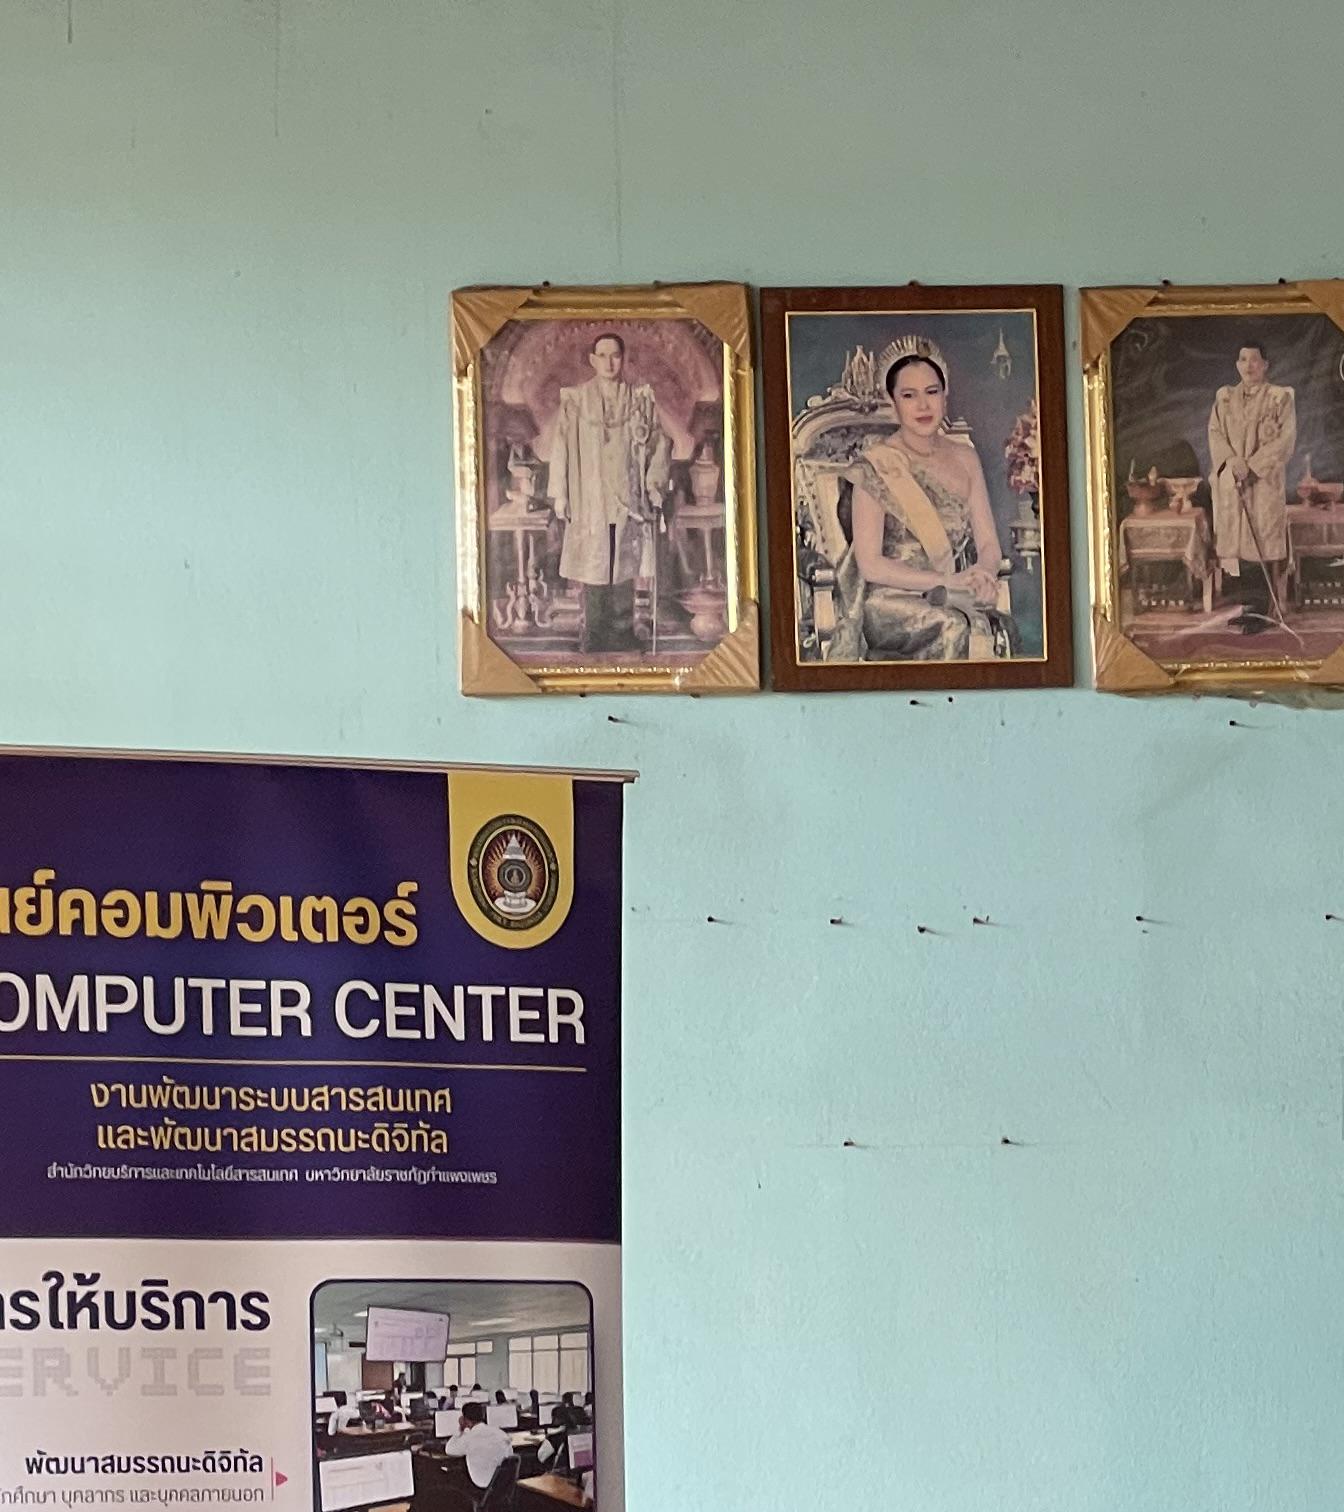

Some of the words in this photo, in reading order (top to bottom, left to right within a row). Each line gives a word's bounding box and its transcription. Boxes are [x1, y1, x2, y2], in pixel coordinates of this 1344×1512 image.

[0, 869, 418, 946] ย์คอมพิวเตอร์
[334, 980, 586, 1044] CENTER
[90, 1075, 452, 1114] งานพัฒนาระบบสารสนเทศ
[97, 1118, 448, 1154] และพัฒนาสมรรถนะดิจิทัล
[0, 1270, 271, 1331] รให้บริการ
[0, 1346, 271, 1397] ERVICE
[25, 1449, 264, 1474] พัฒนาสมรรถนะดิจิทัล
[0, 1485, 56, 1504] กศึกษา
[61, 1487, 125, 1508] บุคลากร
[130, 1487, 265, 1507] และบุคคลภายนอก
